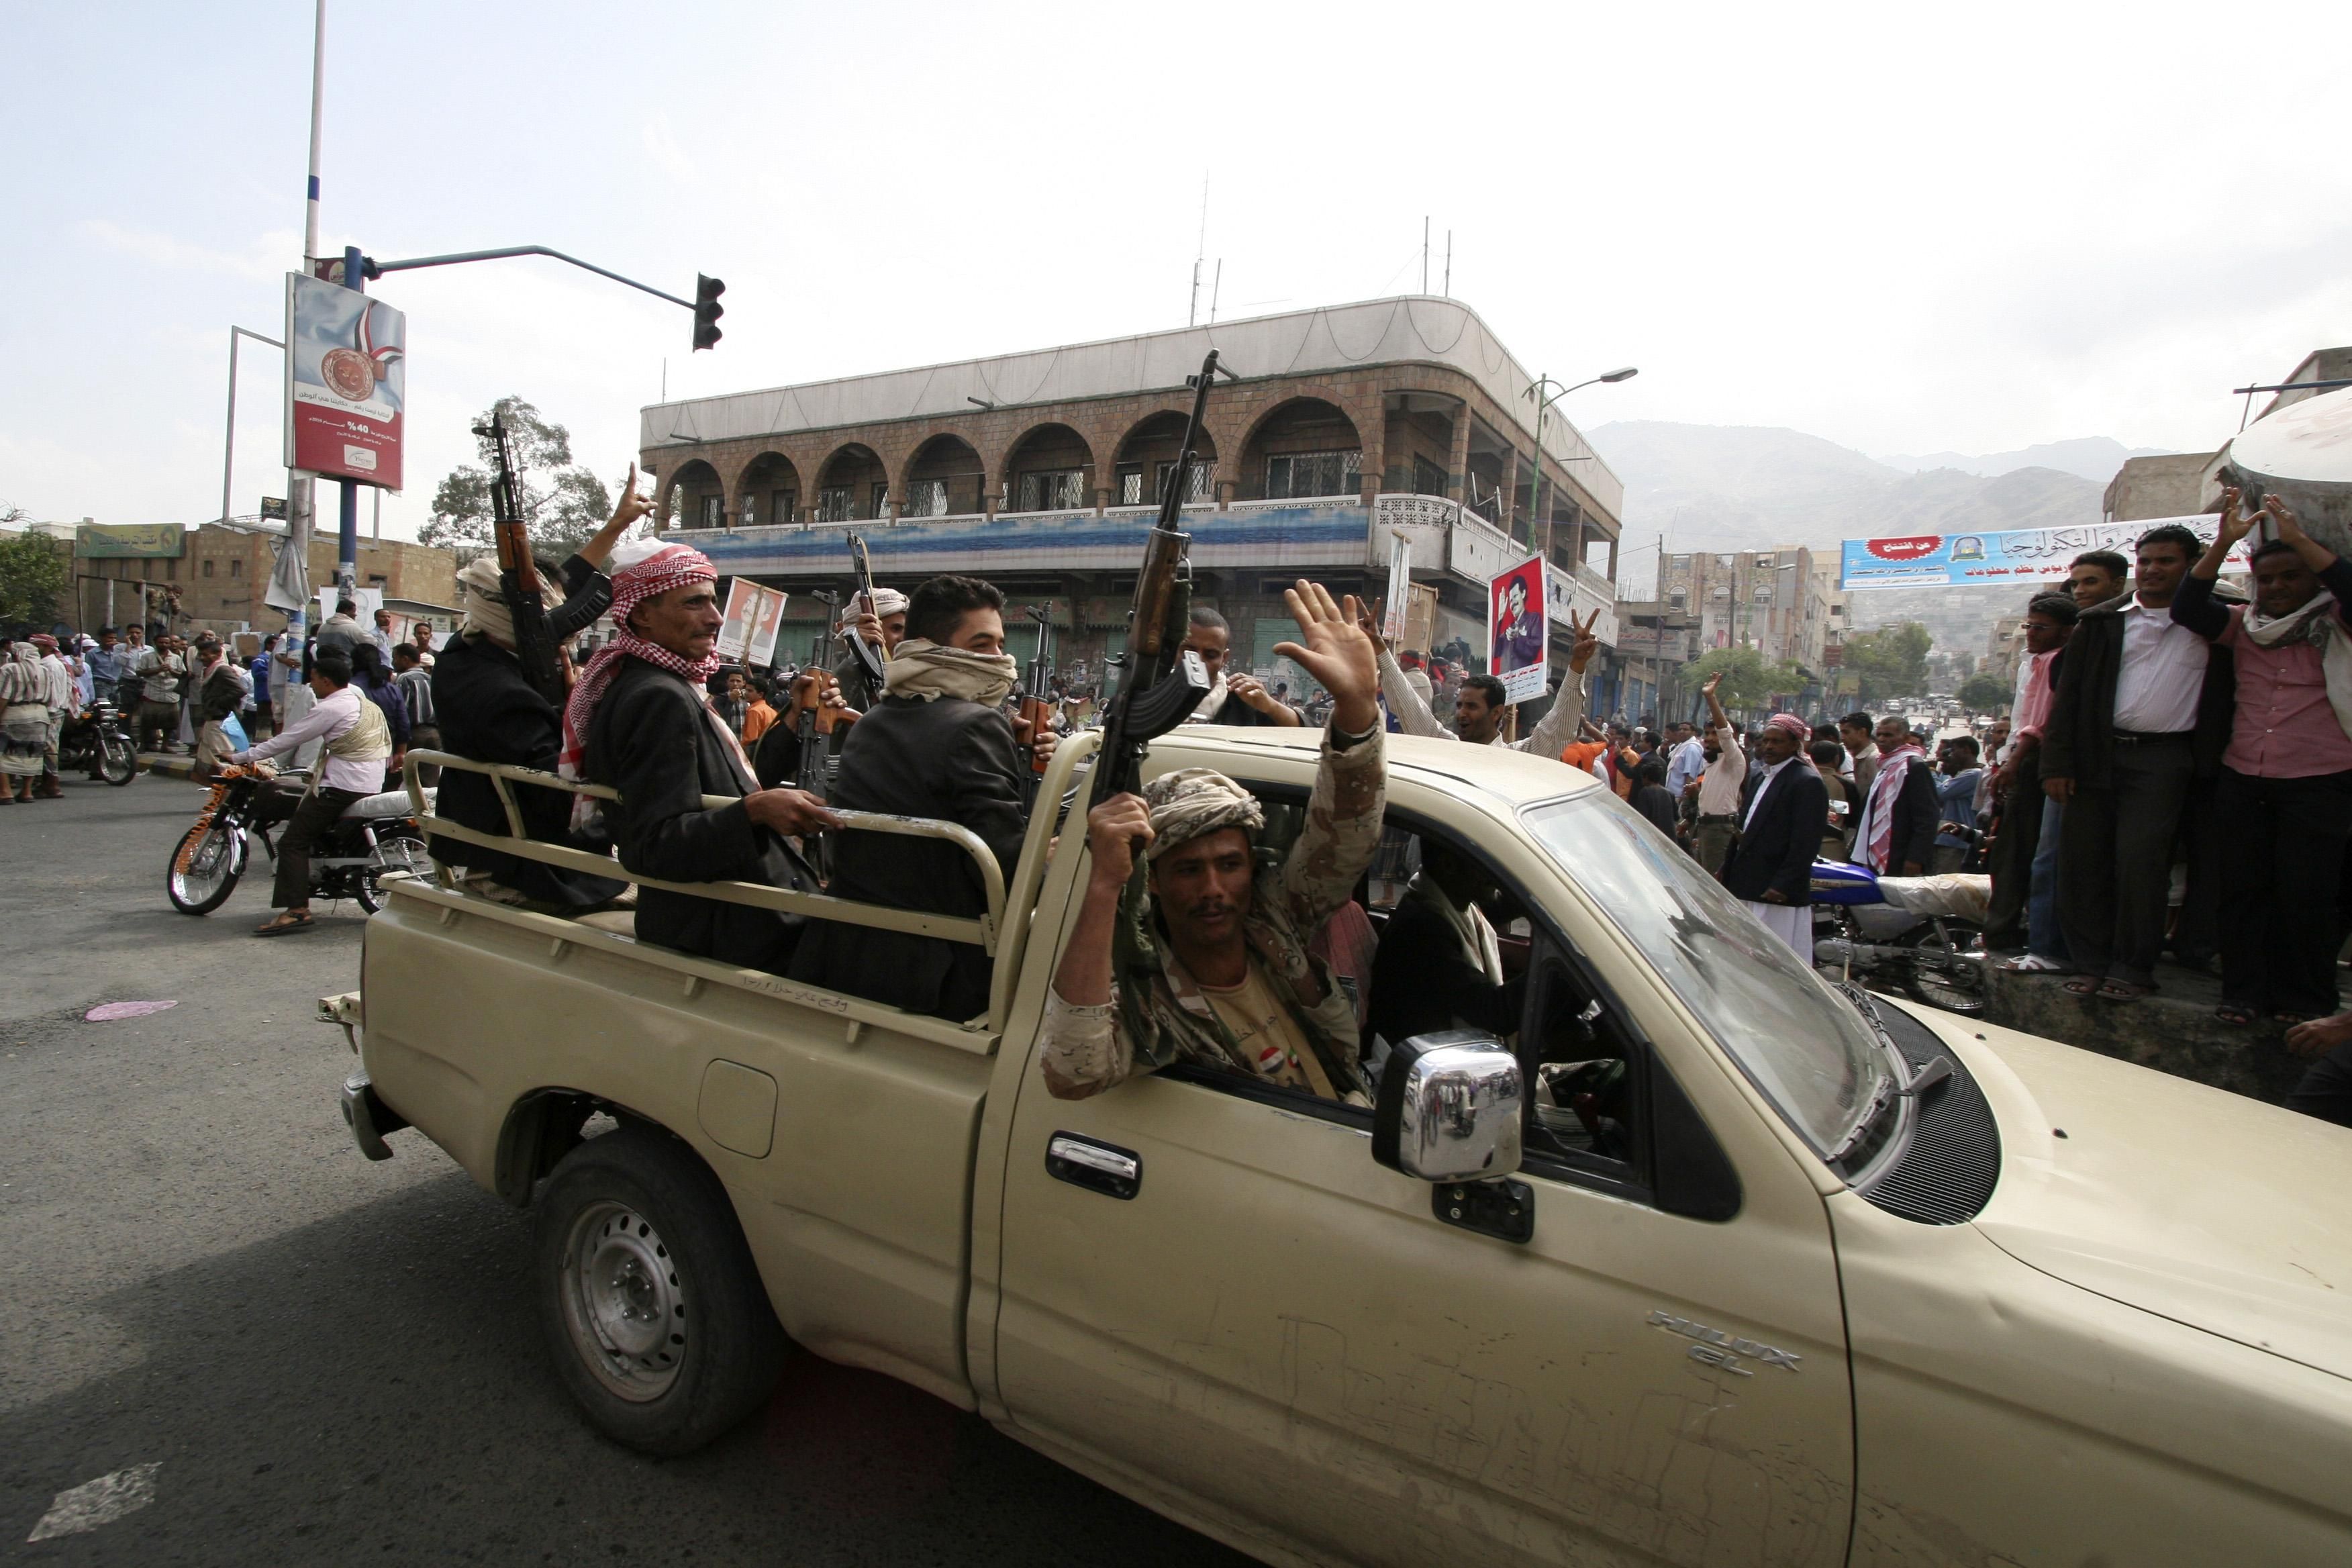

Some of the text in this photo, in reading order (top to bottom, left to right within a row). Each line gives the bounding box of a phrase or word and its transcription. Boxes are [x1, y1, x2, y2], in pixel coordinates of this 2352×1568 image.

[299, 391, 318, 401] الوطن
[1882, 541, 1930, 553] عن افتتاح
[1965, 565, 2010, 577] معلومات
[2014, 562, 2035, 576] نظم
[1646, 1310, 1803, 1372] HILUX
[1687, 1345, 1754, 1376] GL
